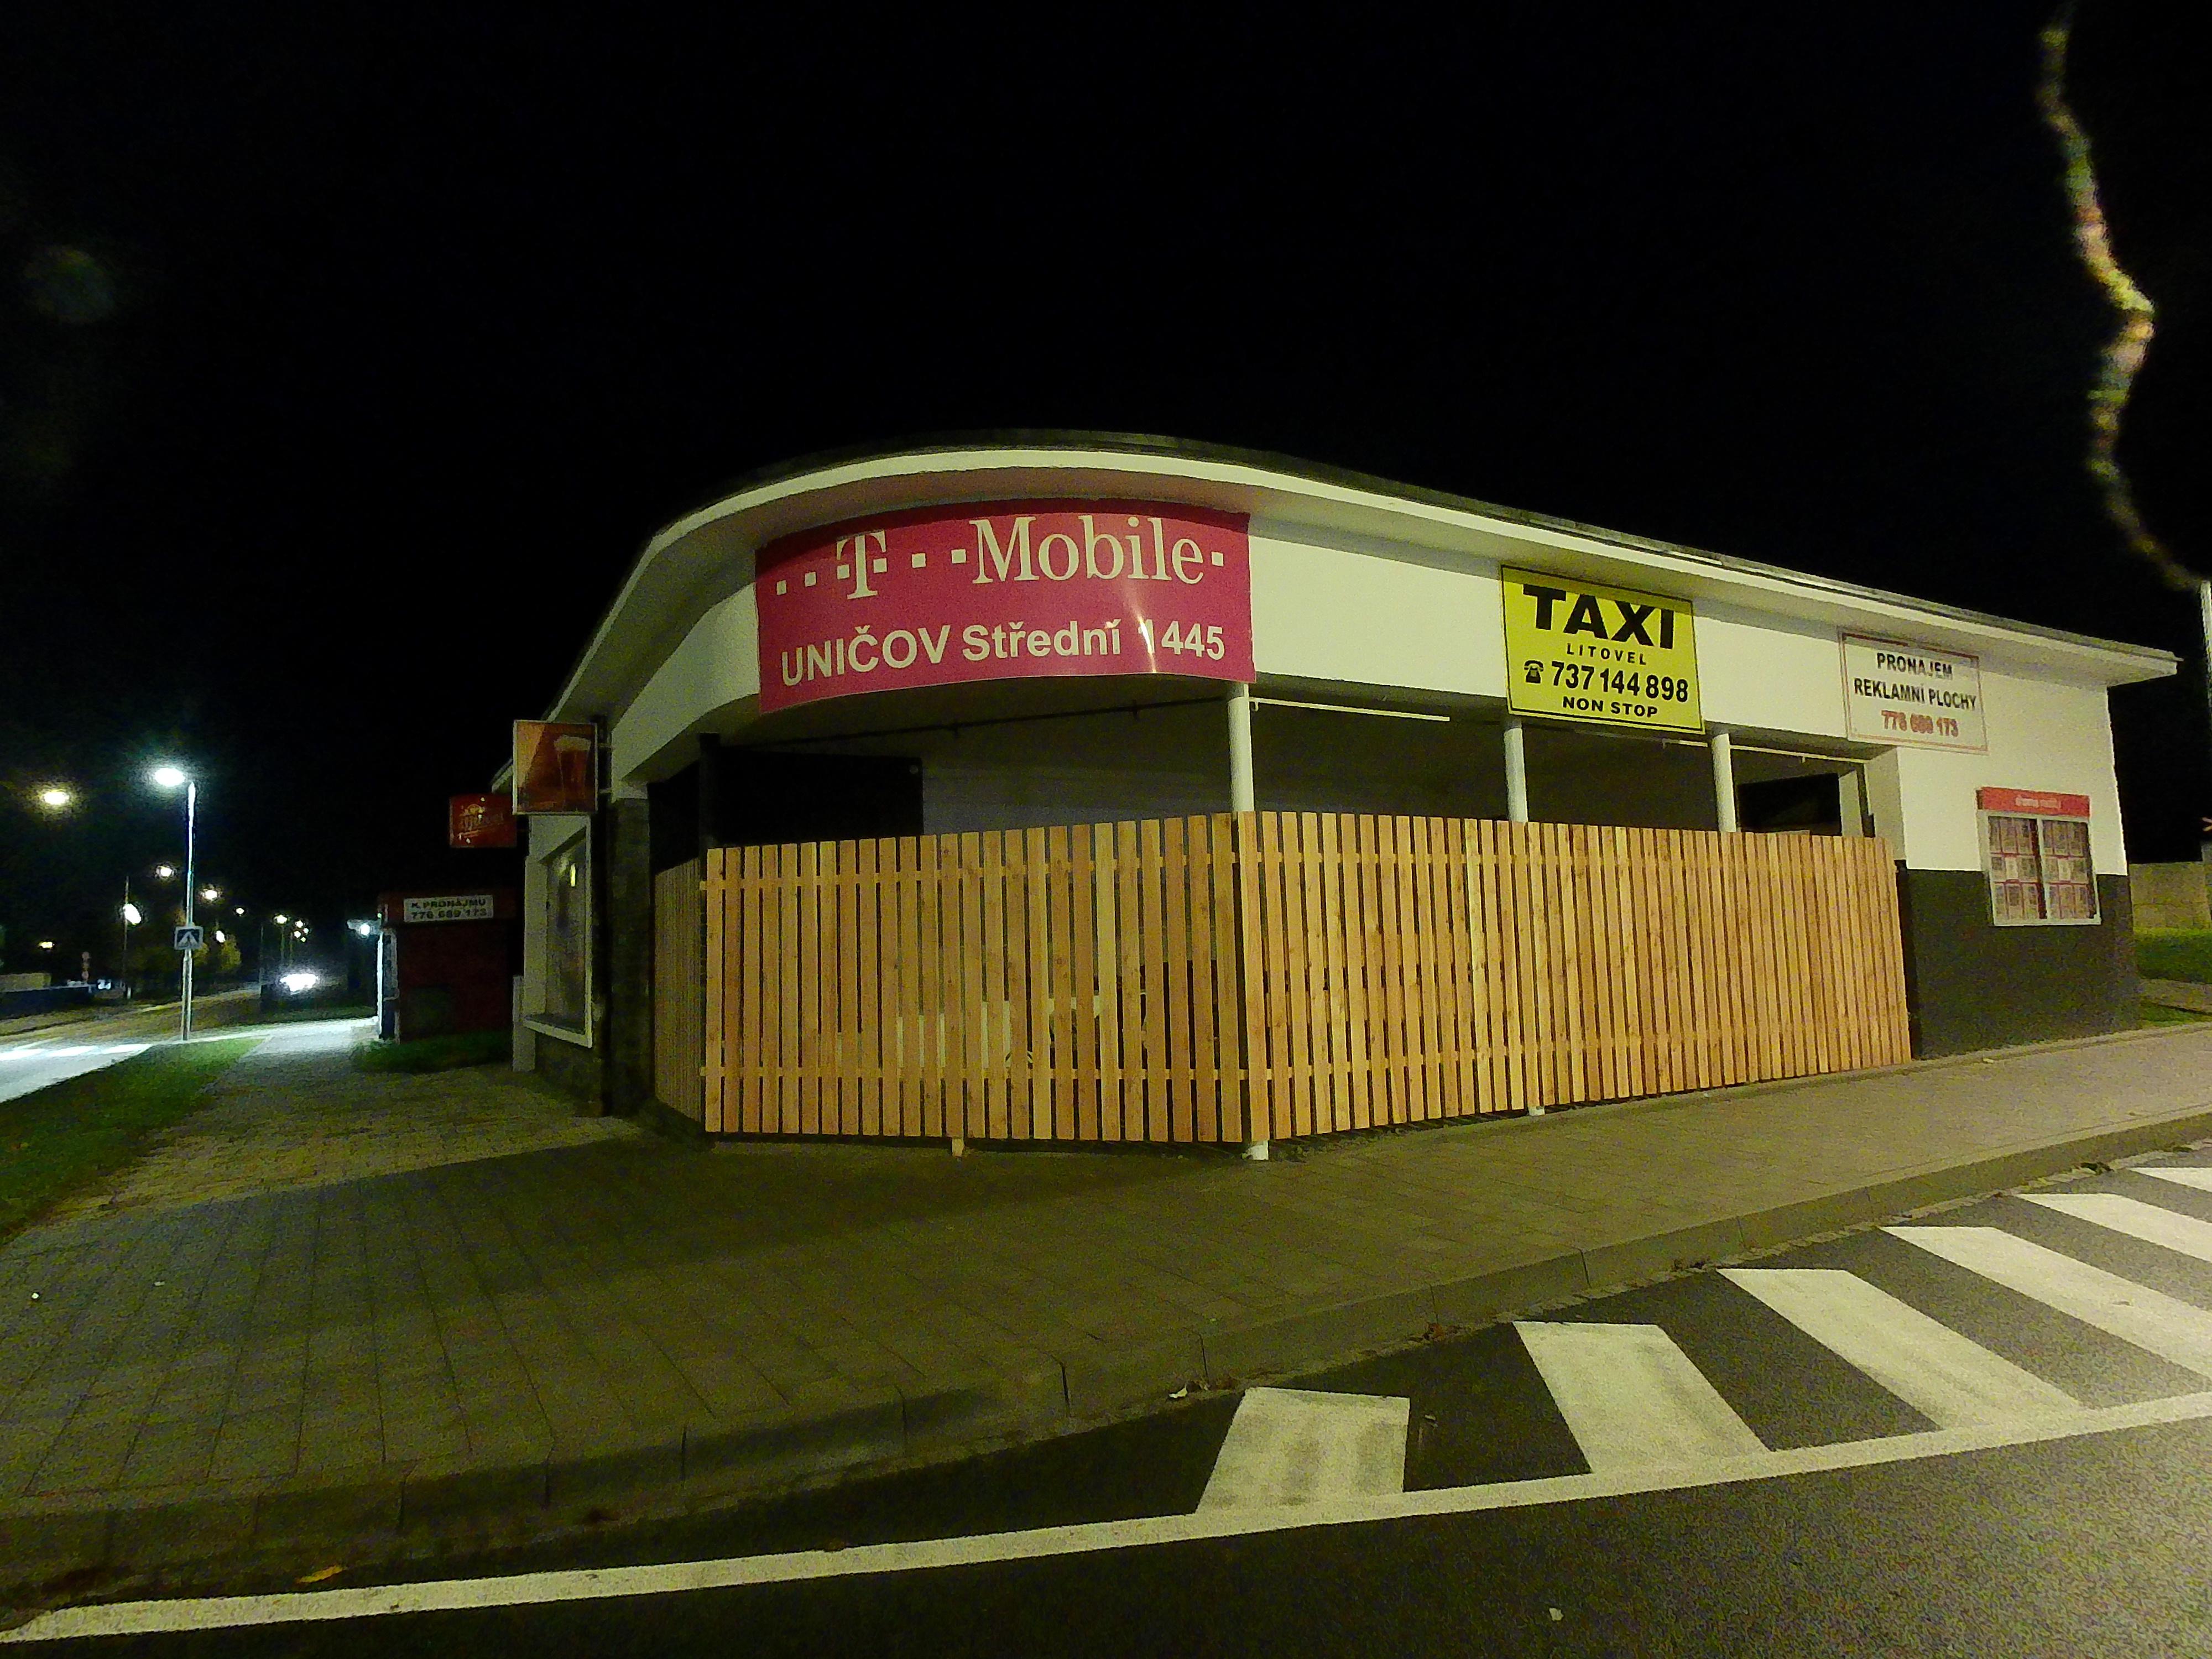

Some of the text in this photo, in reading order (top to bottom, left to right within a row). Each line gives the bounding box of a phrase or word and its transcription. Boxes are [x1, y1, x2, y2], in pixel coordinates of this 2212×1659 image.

[1523, 583, 1674, 650] TAXI
[781, 619, 1225, 686] UNIČOV Střední 1445
[1566, 643, 1647, 665] LITOVEL
[1551, 660, 1689, 703] 737 144 898
[1563, 696, 1658, 717] NON STOP
[1928, 688, 1977, 710] PLOCHY
